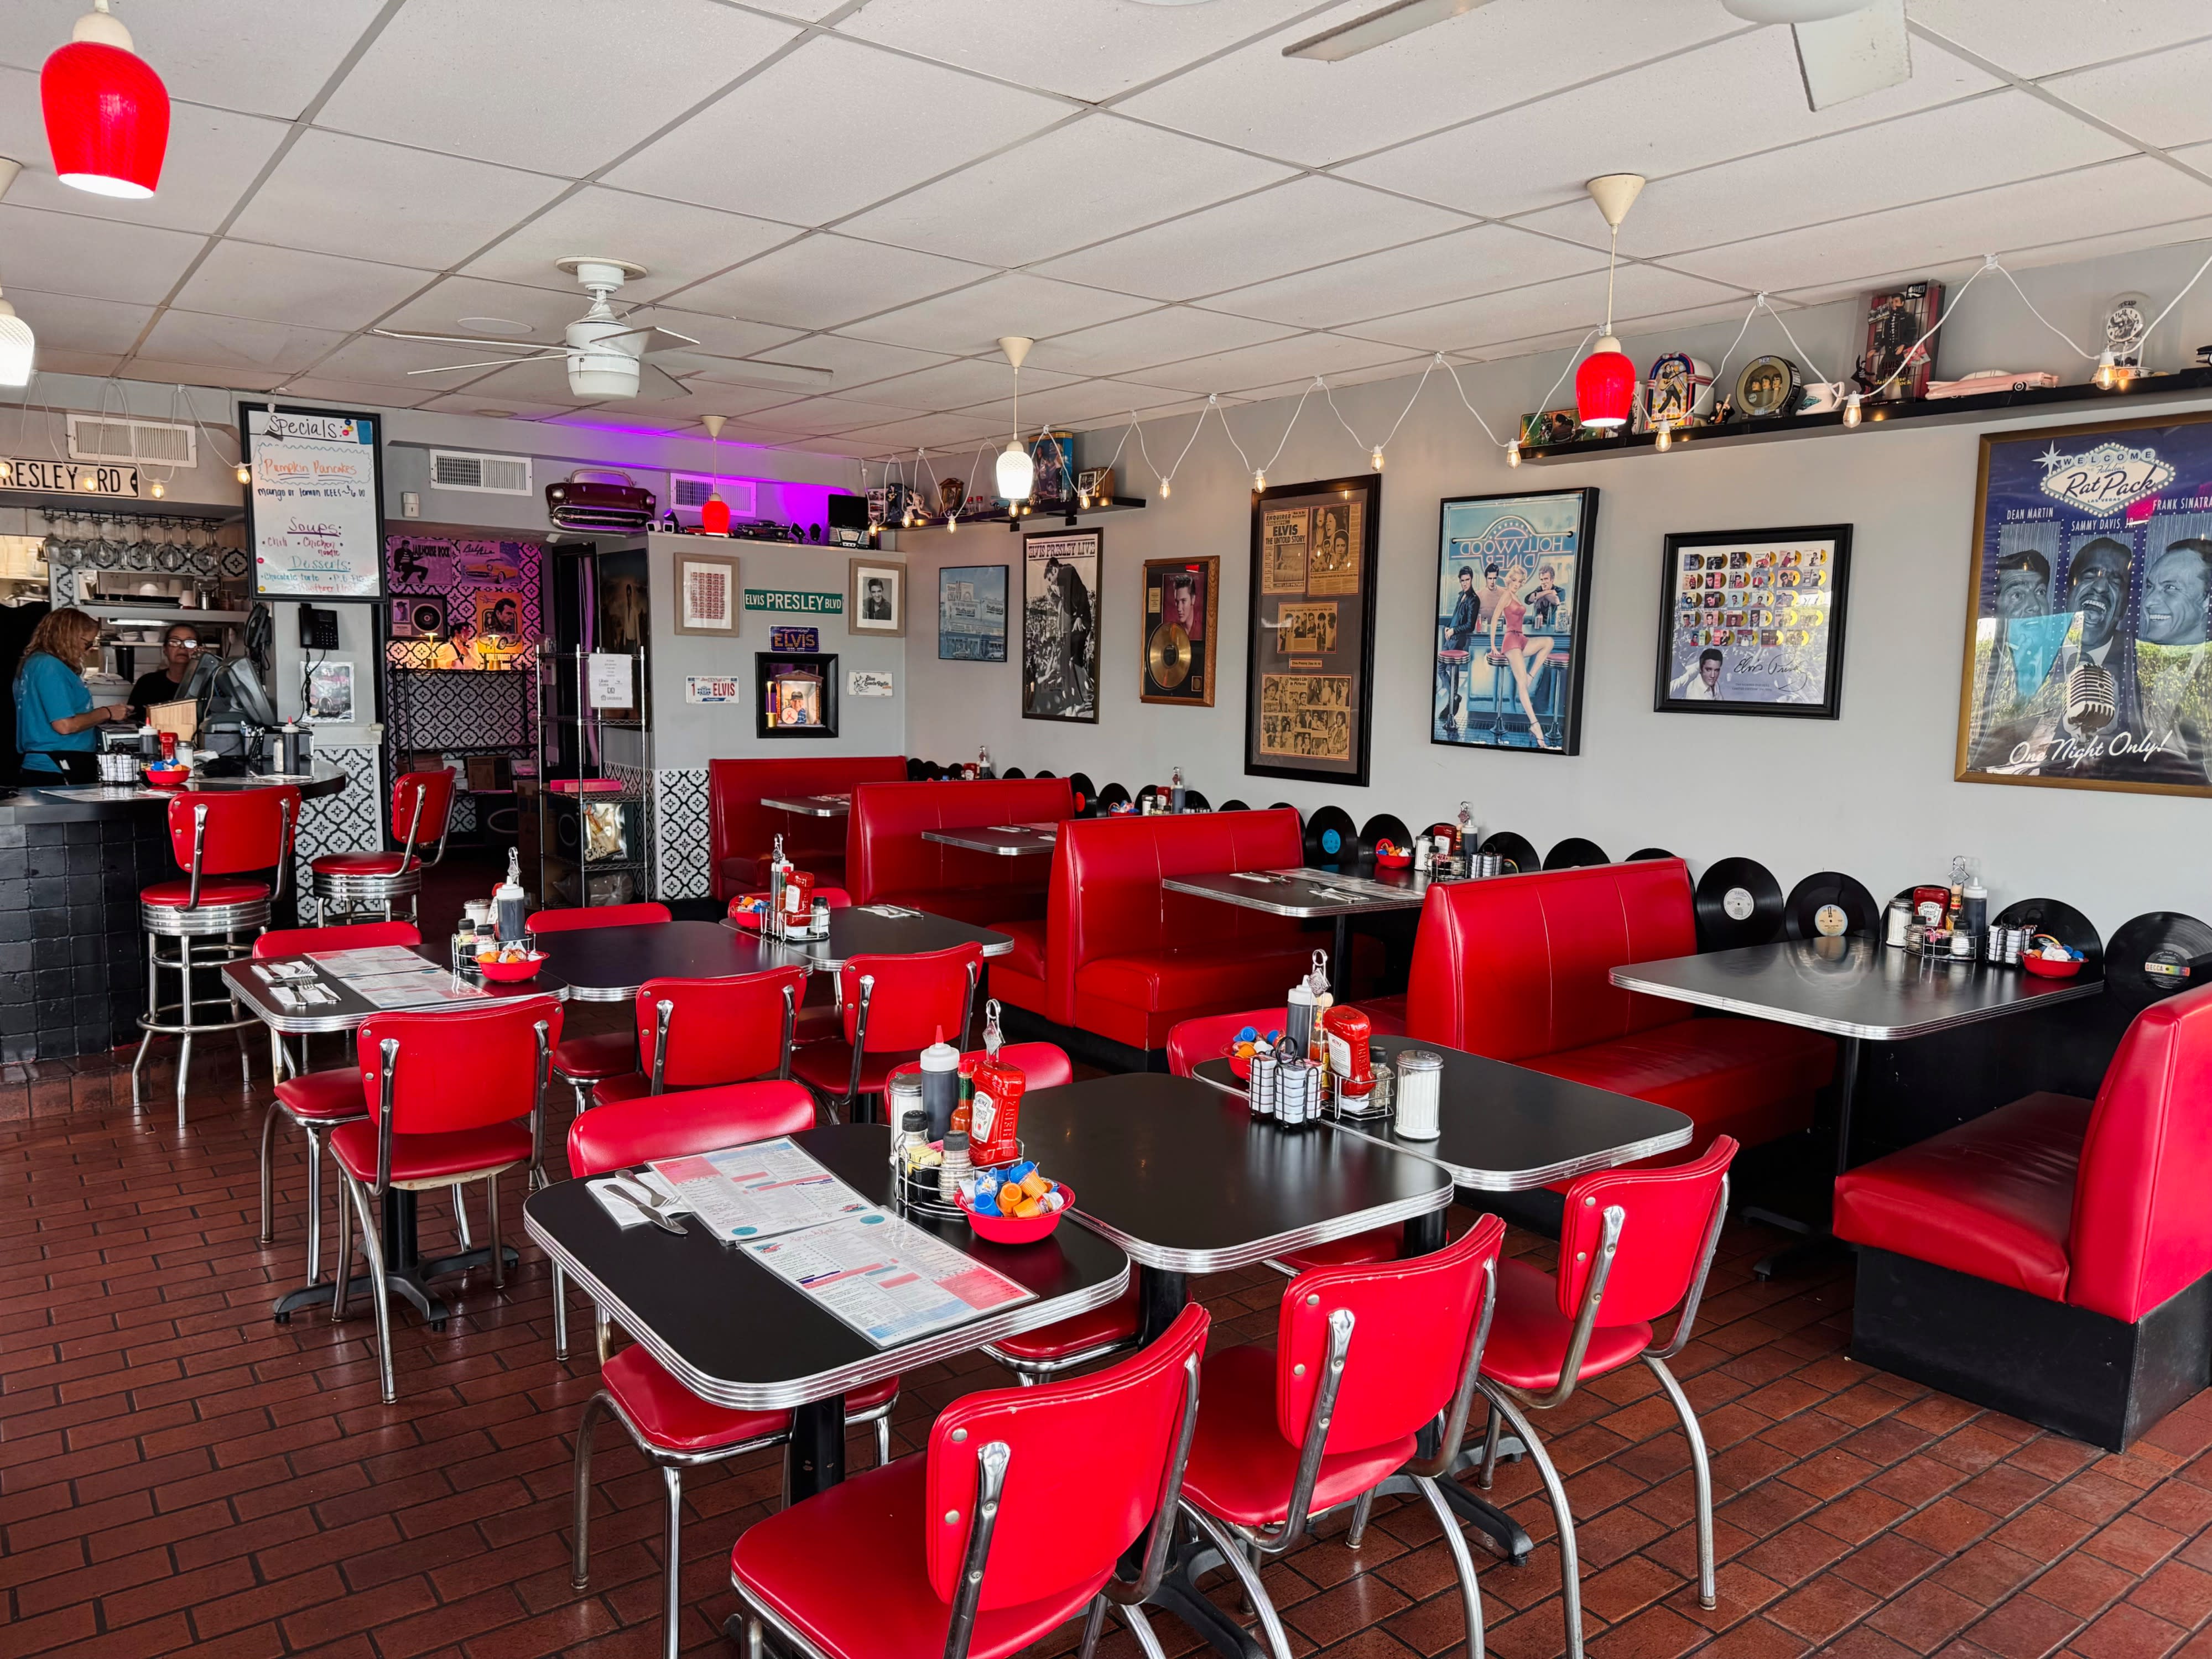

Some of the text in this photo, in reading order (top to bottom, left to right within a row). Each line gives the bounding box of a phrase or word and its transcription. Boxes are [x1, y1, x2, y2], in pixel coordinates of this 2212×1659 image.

[2063, 451, 2152, 466] WELCOME
[264, 458, 357, 474] Pumpkin Pancakes
[2096, 464, 2125, 474] Fabulous
[97, 468, 121, 492] RD
[2062, 463, 2158, 500] Rat Pack
[299, 488, 320, 497] lemon
[2153, 498, 2178, 511] FRANK
[2007, 507, 2054, 520] DEAN MARTIN
[1273, 524, 1298, 537] ELVIS
[2071, 520, 2098, 532] SAMMY
[413, 544, 451, 558] JAILHOUSE ROCK
[1028, 541, 1095, 559] ELVIS PRESLEY LIVE
[745, 593, 842, 611] ELVIS PRESLEY BLVD
[774, 633, 815, 647] ELVIS
[1734, 656, 1763, 674] Elvis
[691, 683, 735, 696] 1 ELVIS
[2010, 729, 2173, 769] One Night Only!
[977, 1098, 987, 1107] HEINZ
